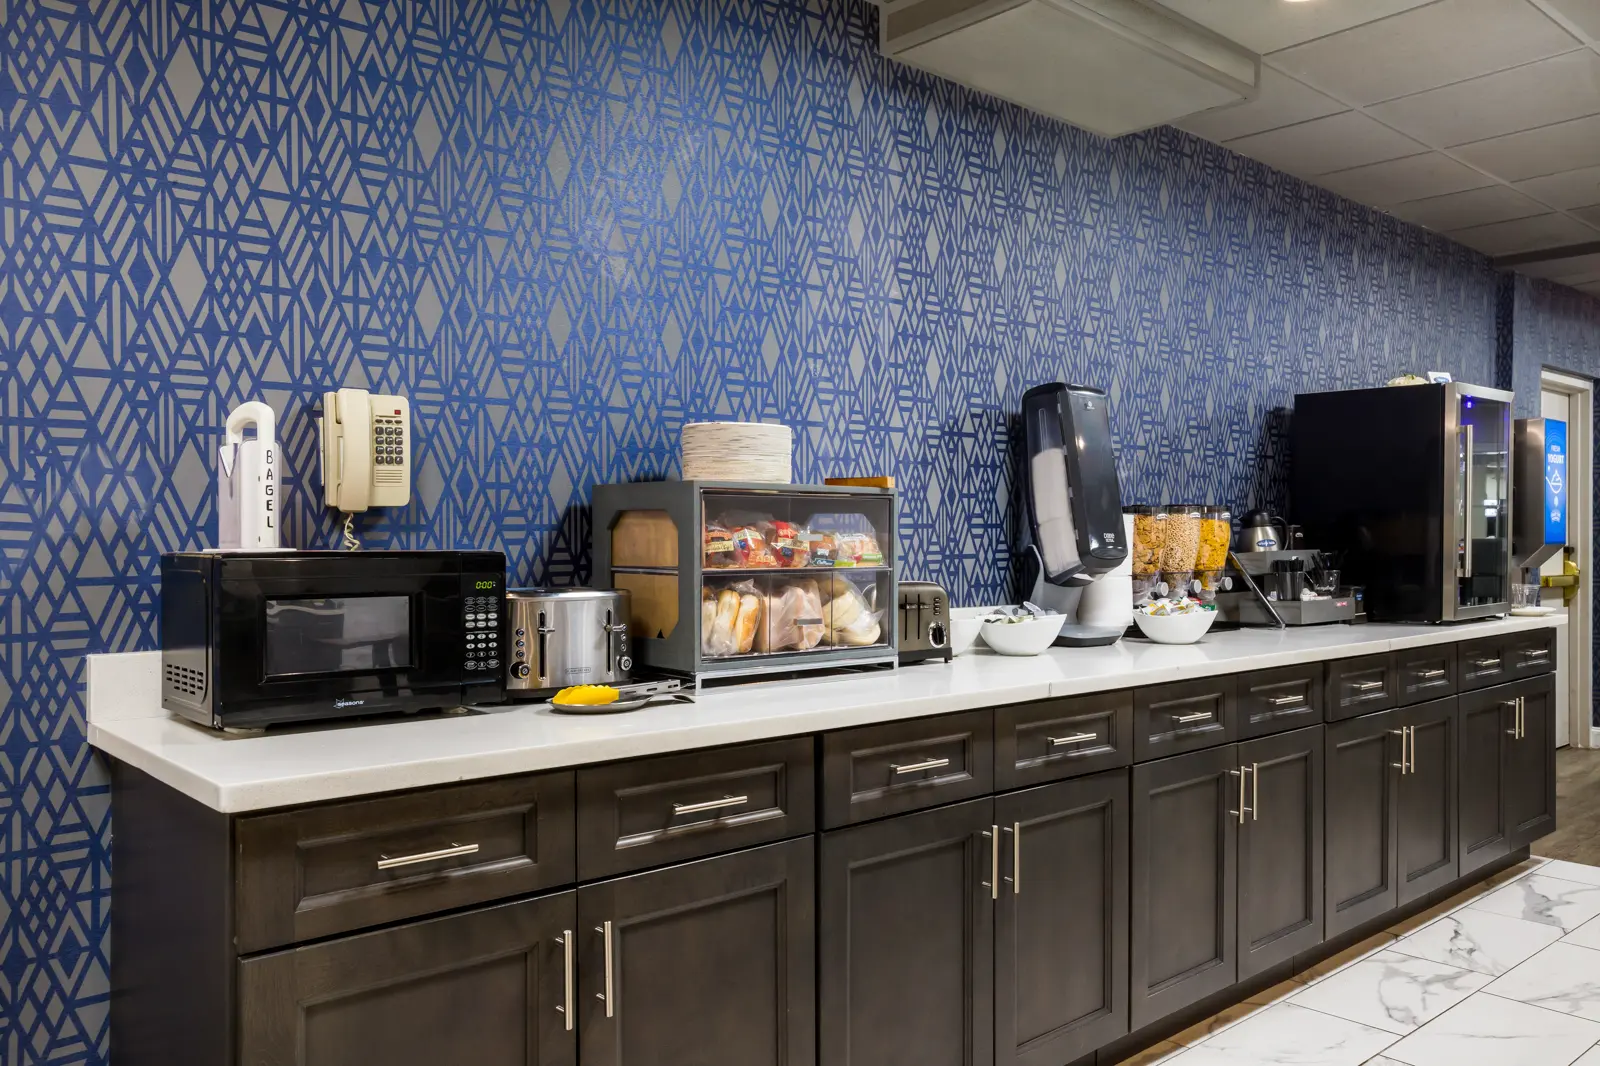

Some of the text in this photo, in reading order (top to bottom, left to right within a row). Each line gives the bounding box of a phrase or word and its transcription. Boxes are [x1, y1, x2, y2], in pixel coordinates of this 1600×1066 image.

[1547, 454, 1564, 464] YOGURT
[265, 449, 274, 529] BAGEL
[476, 581, 492, 590] 0:00
